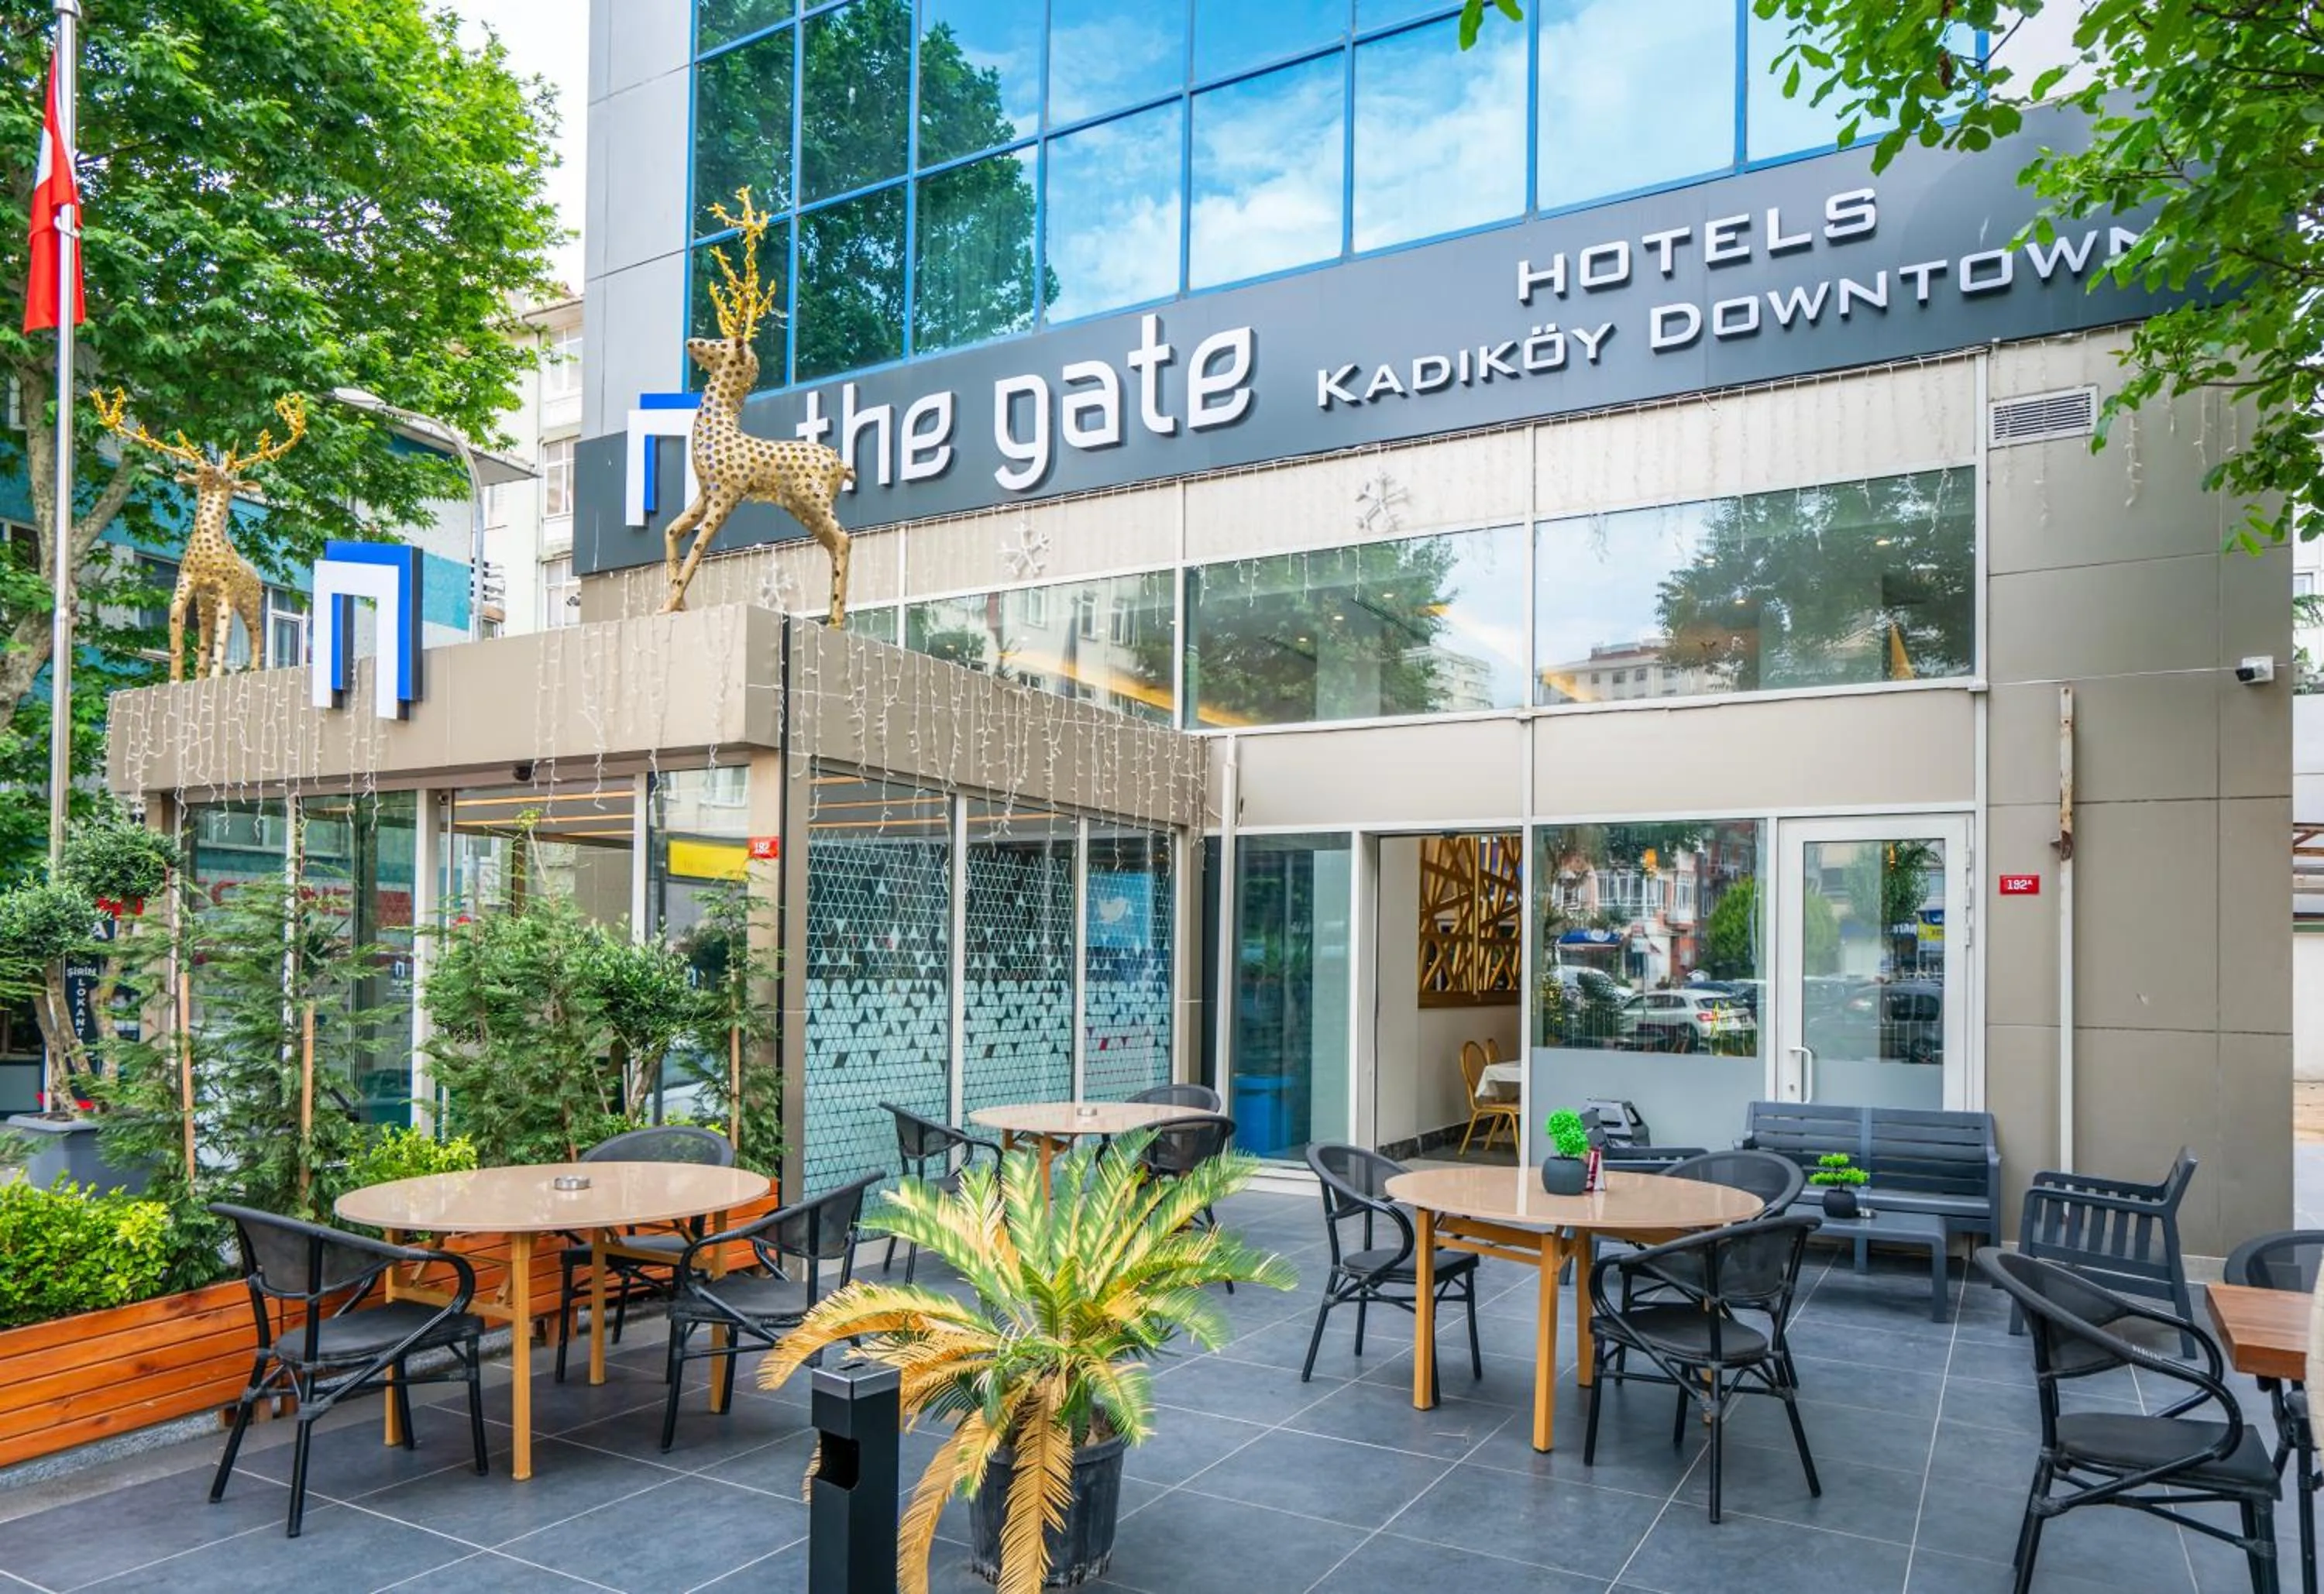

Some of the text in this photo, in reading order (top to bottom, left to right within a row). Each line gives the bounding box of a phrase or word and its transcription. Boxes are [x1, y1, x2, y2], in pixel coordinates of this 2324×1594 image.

[1518, 188, 1876, 301] HOTELS
[796, 313, 1252, 492] the gate
[1318, 322, 1613, 407] KADIKÖY
